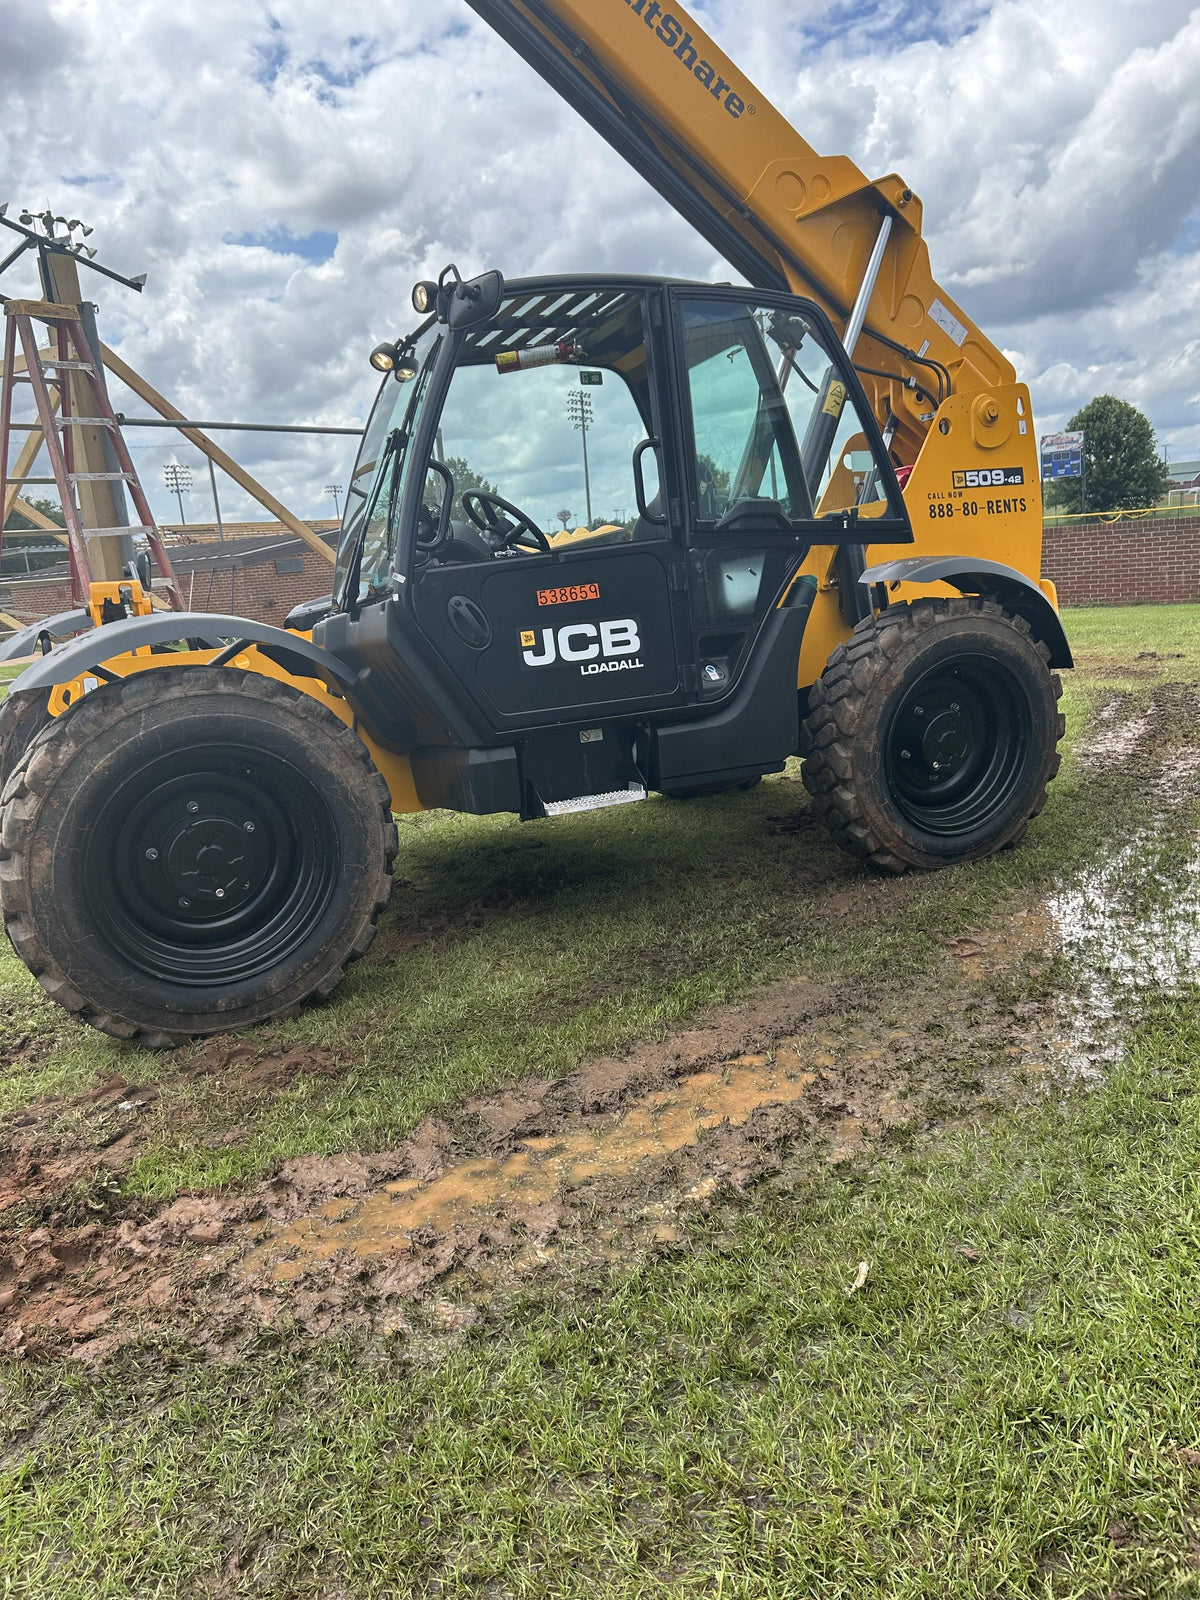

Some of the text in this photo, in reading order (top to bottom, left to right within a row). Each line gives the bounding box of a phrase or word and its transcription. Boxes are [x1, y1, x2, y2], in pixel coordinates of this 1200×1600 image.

[927, 492, 945, 500] CALL
[929, 498, 1027, 518] 888-80-RENTS
[538, 584, 599, 605] 538659
[522, 618, 641, 667] JCB
[580, 658, 644, 675] LOADALL
